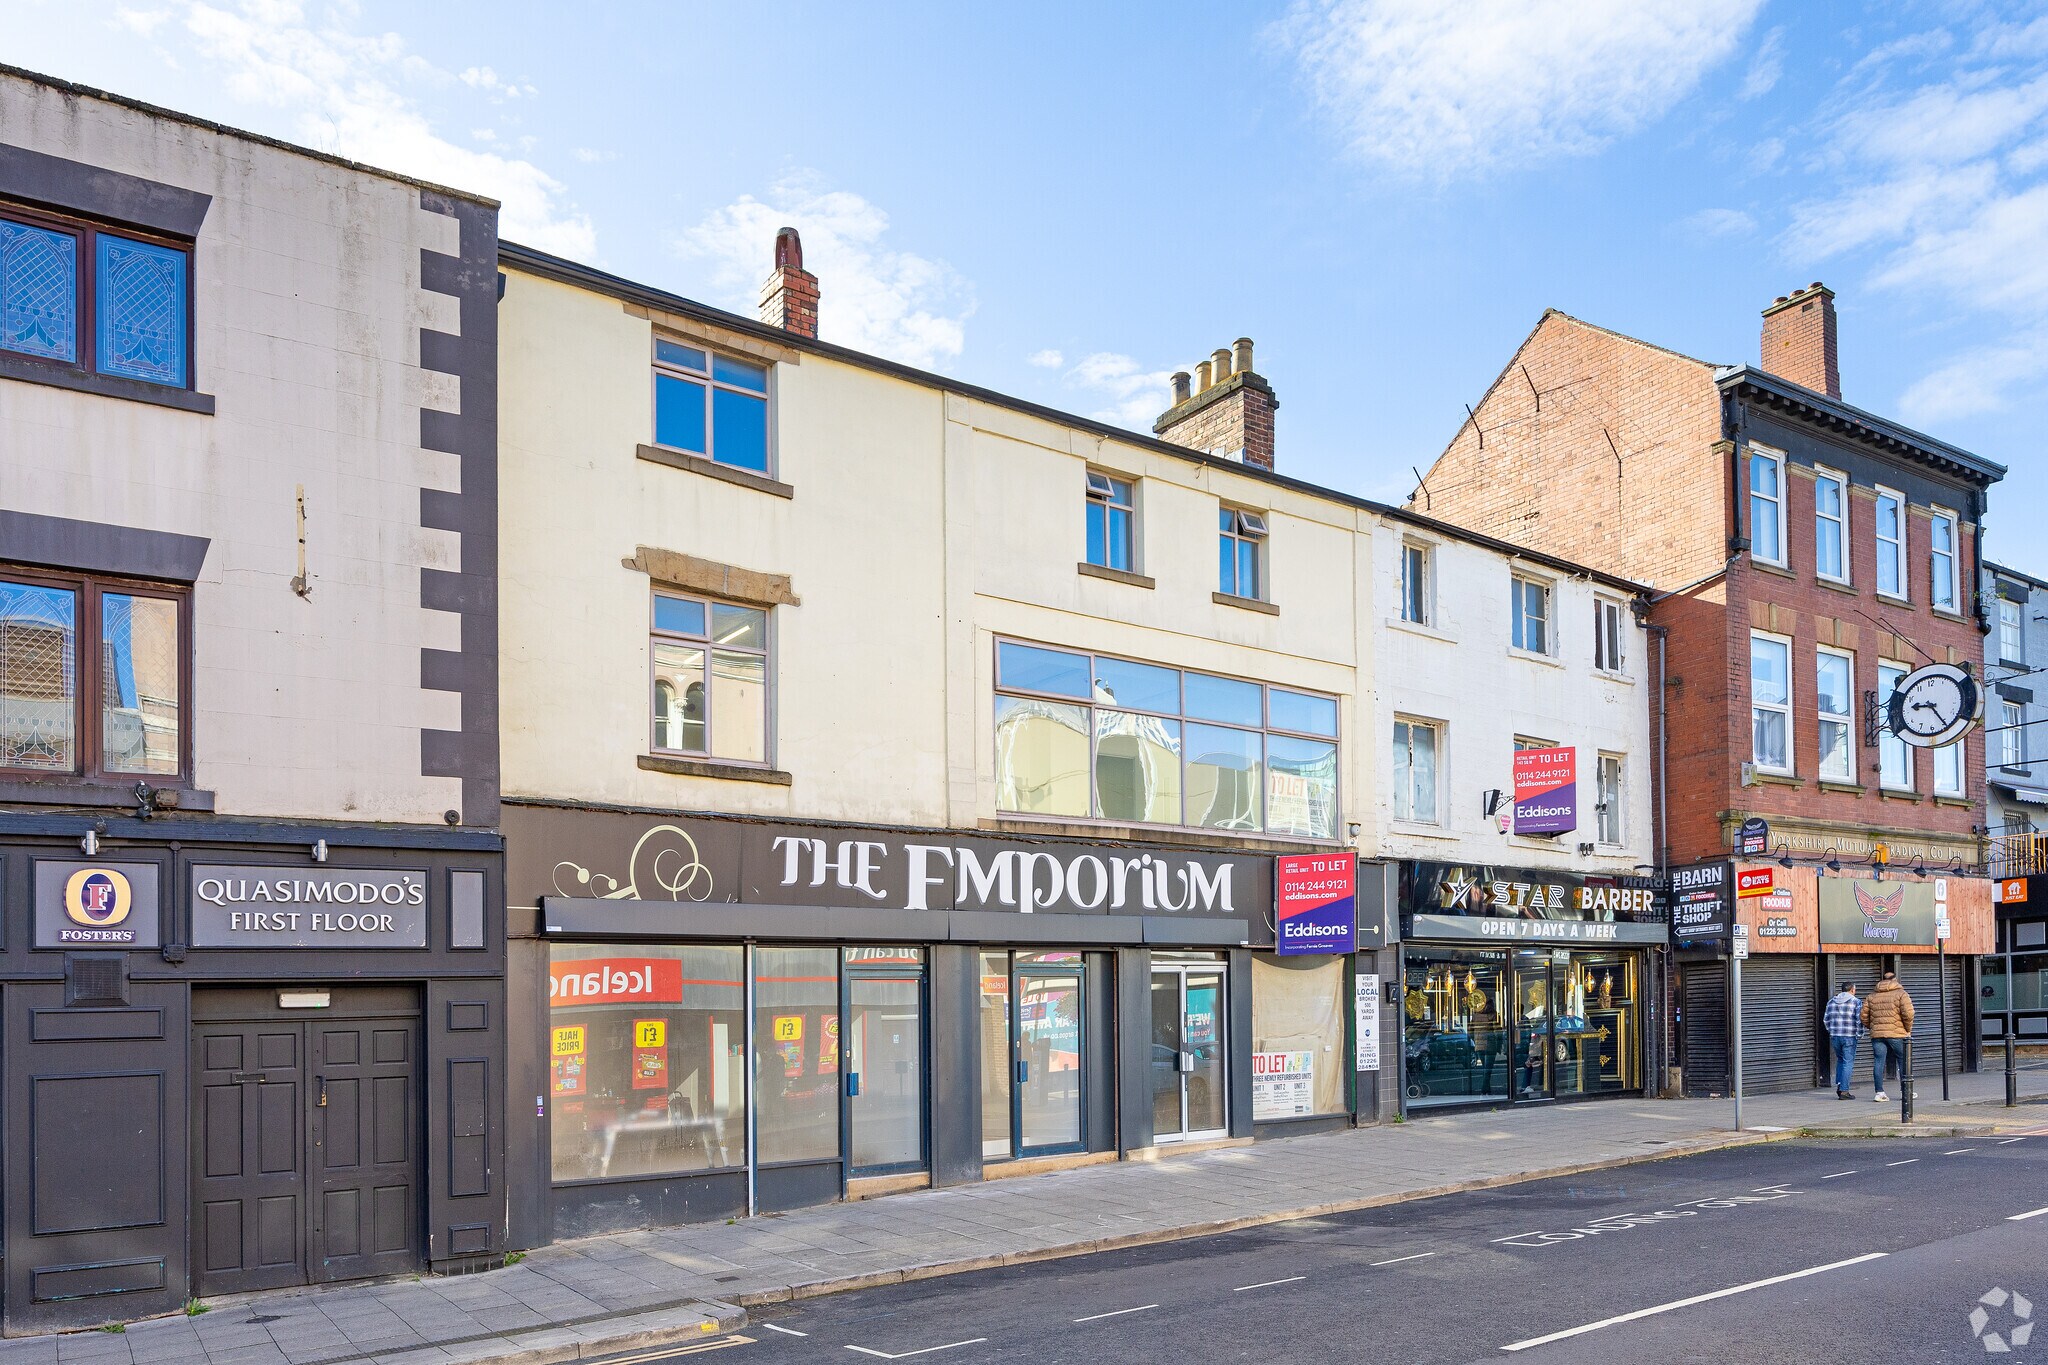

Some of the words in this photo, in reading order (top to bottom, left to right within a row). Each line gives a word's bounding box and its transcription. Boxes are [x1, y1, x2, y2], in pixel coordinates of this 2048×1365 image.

[1539, 754, 1550, 764] TO
[1554, 753, 1570, 762] LET
[1516, 772, 1534, 780] 0114
[1536, 770, 1551, 779] 244
[1552, 769, 1570, 778] 9121
[1272, 776, 1284, 794] TO
[1286, 777, 1304, 796] LET
[1516, 780, 1562, 788] eddisons.com
[1517, 805, 1572, 818] Eddisons
[1770, 832, 1828, 850] YORKSHIRE
[772, 836, 888, 900] THE
[1312, 862, 1325, 872] TO
[1328, 860, 1346, 870] LET
[1682, 866, 1722, 886] BARN
[1752, 878, 1770, 886] EATS
[197, 876, 425, 907] QUASIMODO'S
[1285, 882, 1305, 892] 0114
[1307, 881, 1325, 890] 244
[1327, 880, 1347, 889] 9121
[87, 884, 112, 910] F
[1285, 892, 1338, 900] eddisons.com
[1490, 881, 1564, 908] STAR
[1581, 886, 1654, 912] BARBER
[1762, 897, 1792, 908] FOODHUB
[1682, 900, 1722, 914] THRIFT
[230, 912, 301, 932] FIRST
[311, 912, 396, 933] FLOOR
[1682, 912, 1712, 924] SHOP
[60, 930, 134, 940] FOSTER'S
[1285, 922, 1348, 938] Eddisons
[1481, 921, 1516, 936] OPEN
[1520, 922, 1528, 936] 7
[1533, 922, 1565, 938] DAYS
[1570, 924, 1579, 937] A
[1586, 924, 1617, 938] WEEK
[1863, 922, 1898, 942] Mercury
[1408, 972, 1426, 983] OPEN
[1357, 988, 1378, 996] LOCAL
[1252, 1055, 1266, 1074] TO
[1268, 1054, 1286, 1073] LET
[1264, 1074, 1276, 1082] NEWLY
[1302, 1072, 1312, 1080] UNITS
[1294, 1082, 1302, 1090] UNIT
[1503, 1210, 1698, 1247] LOADING
[1697, 1189, 1804, 1208] ONLY
